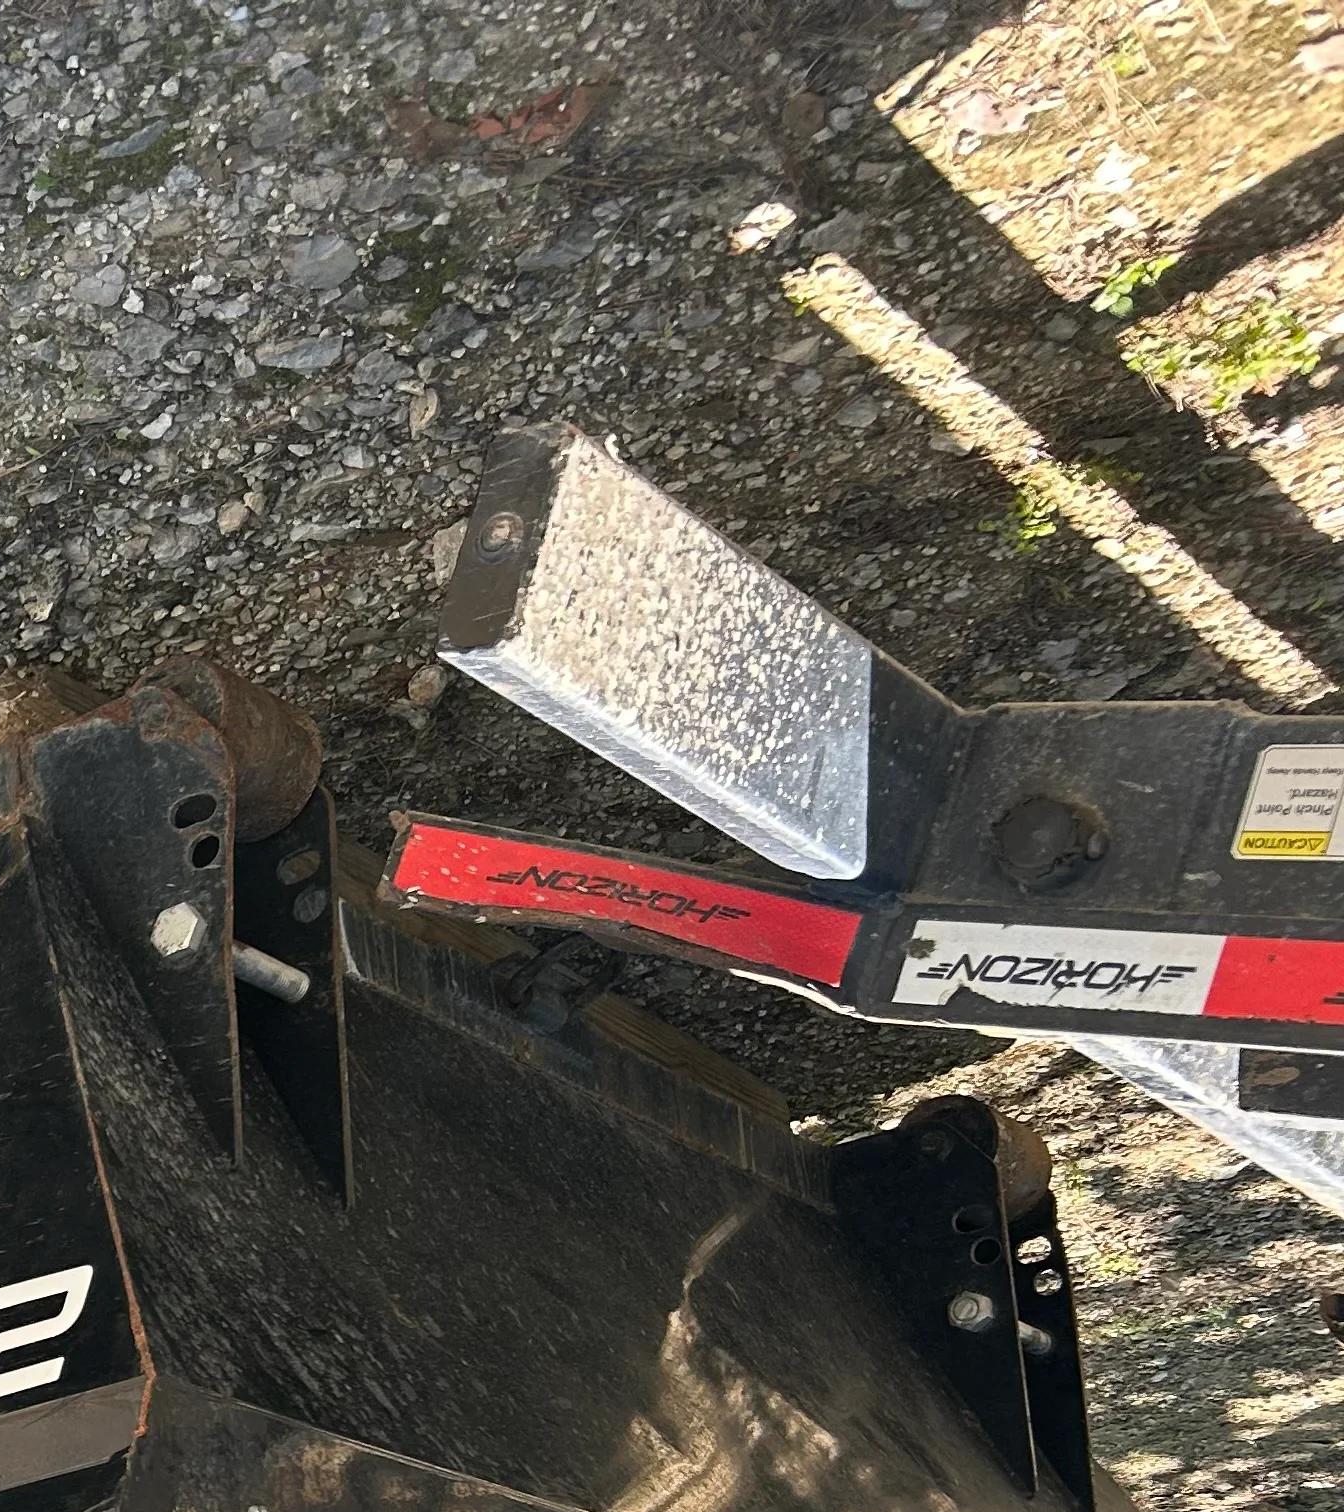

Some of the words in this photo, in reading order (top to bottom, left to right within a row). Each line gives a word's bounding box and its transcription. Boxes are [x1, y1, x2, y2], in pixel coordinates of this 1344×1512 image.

[1256, 804, 1292, 815] Point
[1296, 804, 1334, 815] Pinch
[1244, 838, 1307, 849] CAUTION
[513, 864, 719, 924] HORIZON
[950, 952, 1162, 994] HORIZON
